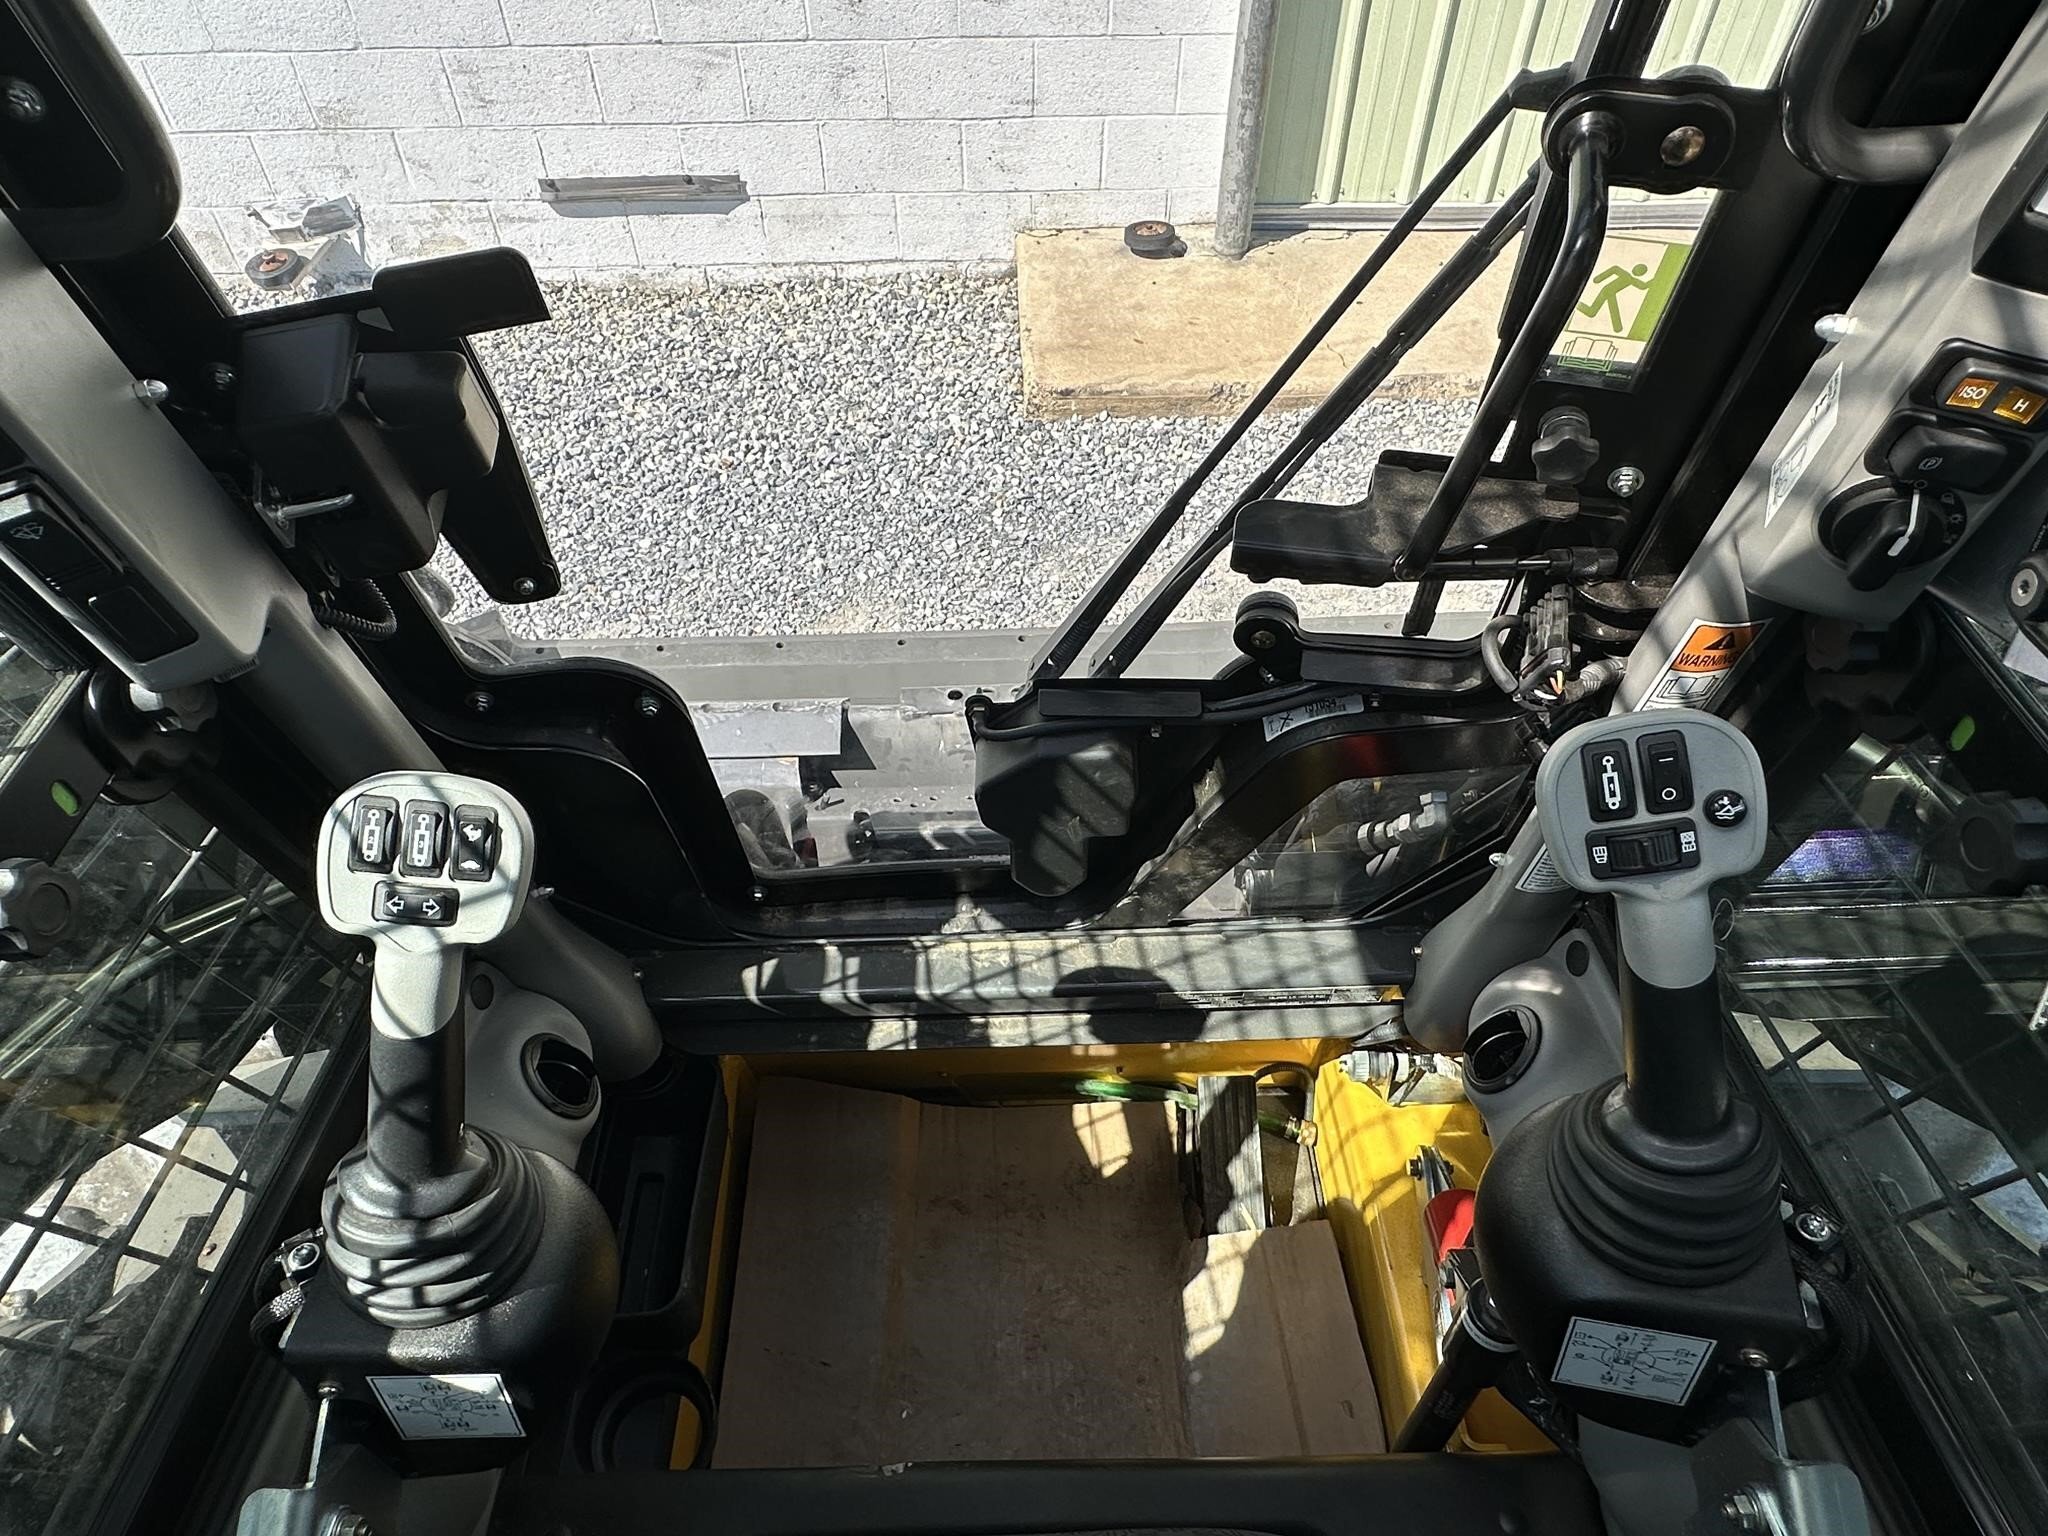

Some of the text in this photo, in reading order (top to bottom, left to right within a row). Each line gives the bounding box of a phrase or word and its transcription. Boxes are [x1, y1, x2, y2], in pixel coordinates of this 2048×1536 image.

[1959, 385, 1987, 400] ISO
[2012, 398, 2030, 413] H
[1678, 652, 1738, 668] WARNING
